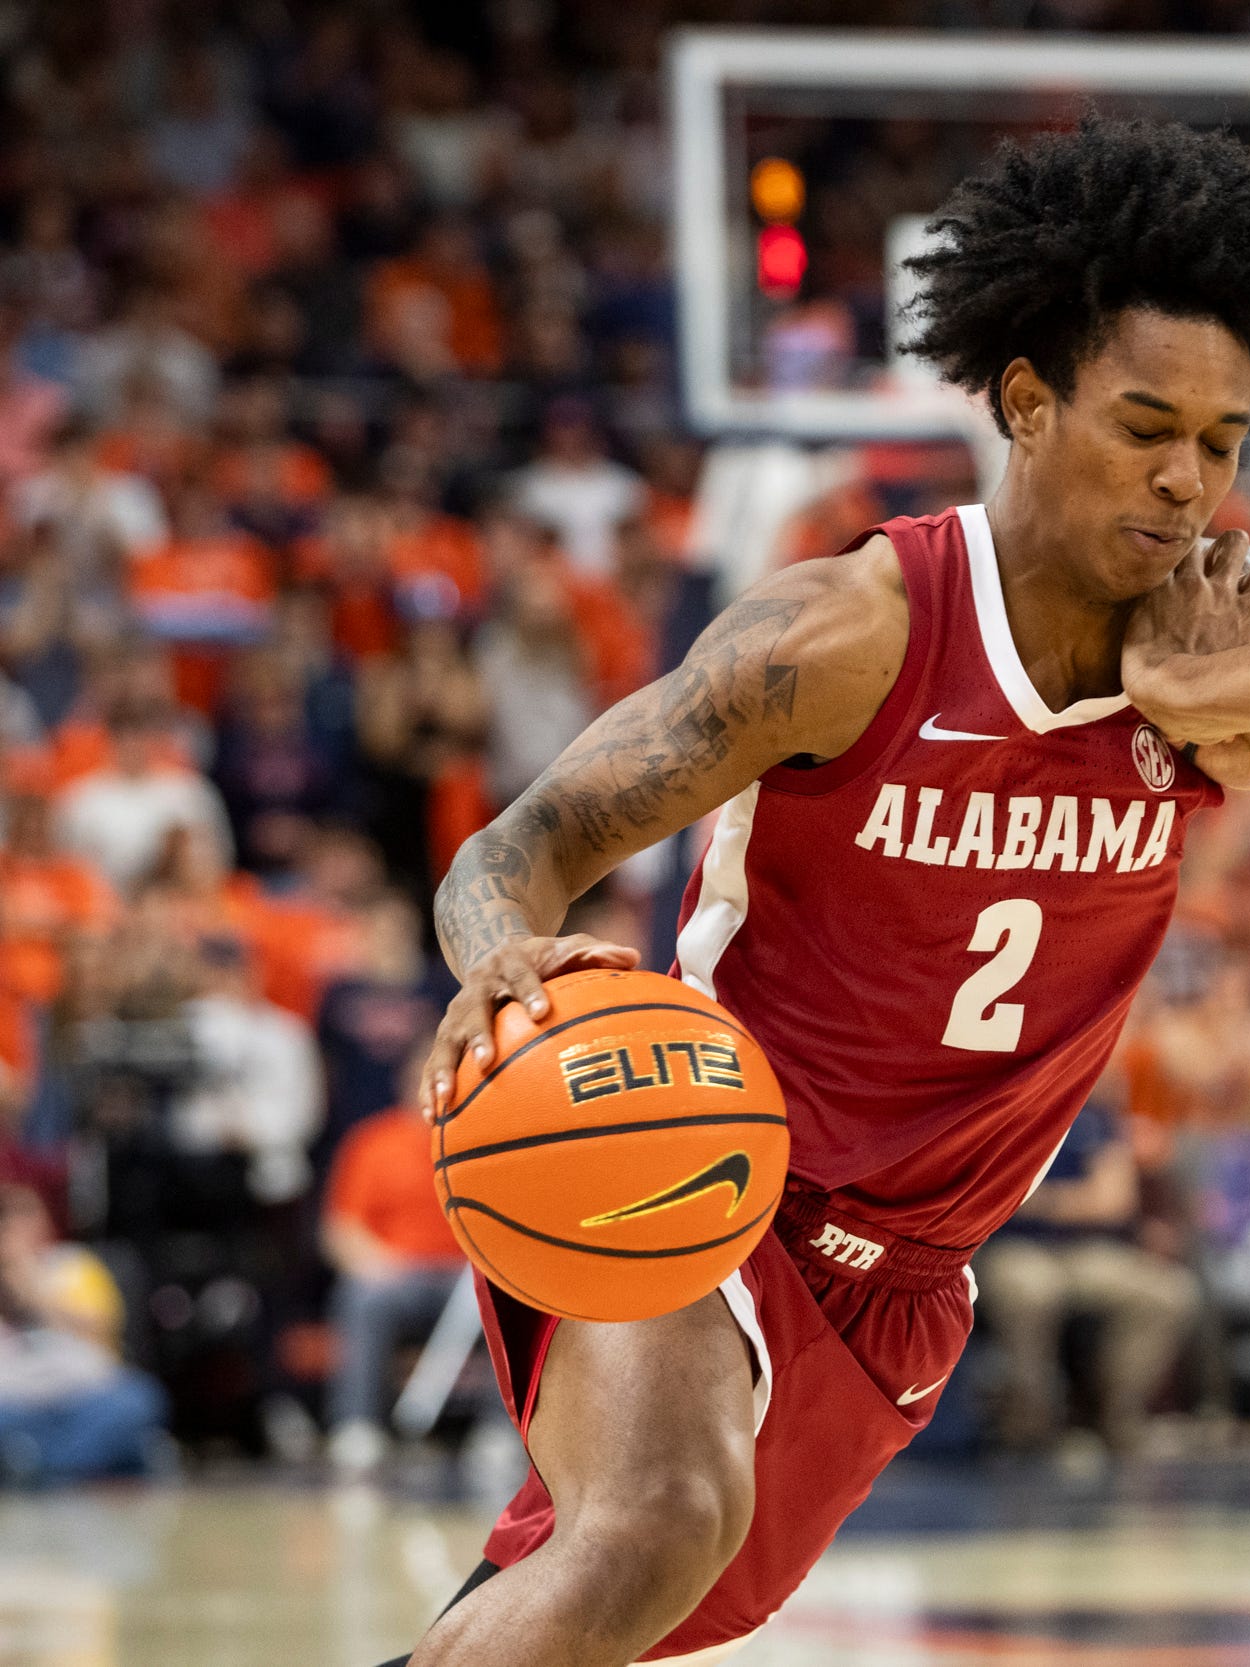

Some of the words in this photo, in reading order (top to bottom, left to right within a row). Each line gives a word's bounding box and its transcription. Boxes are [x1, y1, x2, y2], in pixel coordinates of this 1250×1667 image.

[1135, 727, 1172, 787] SEC
[854, 783, 1177, 874] ALABAMA
[940, 898, 1043, 1052] 2
[558, 1039, 747, 1107] ELITE
[808, 1222, 885, 1270] RTR
